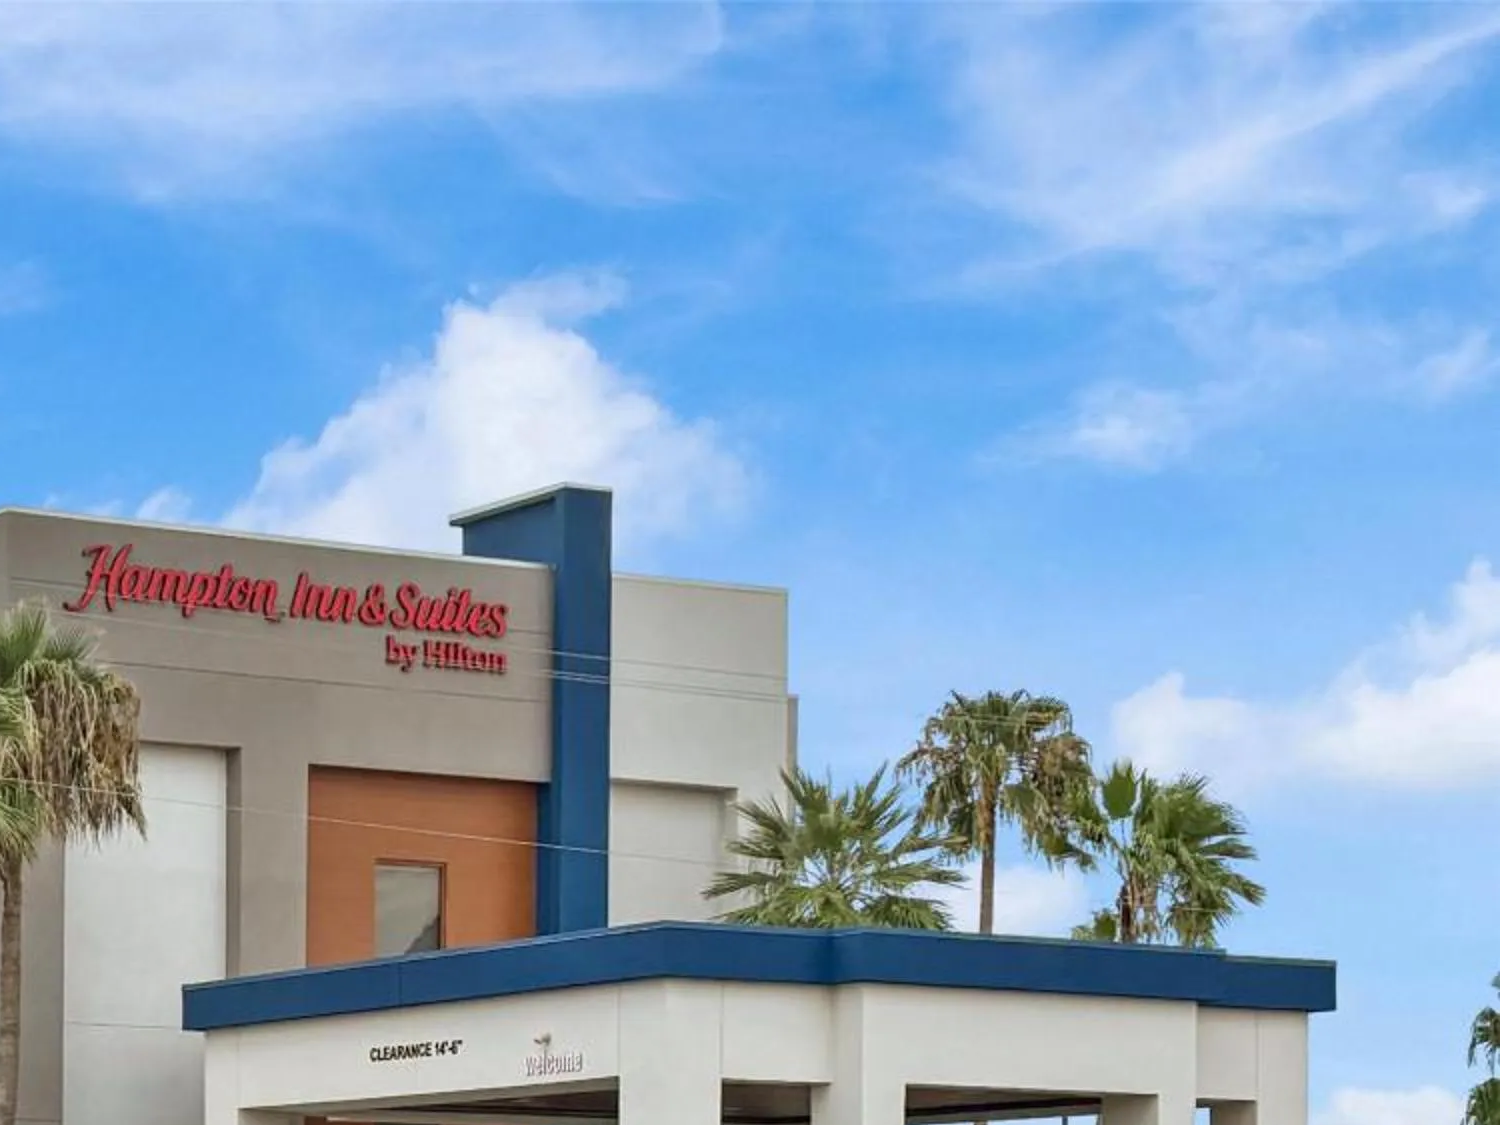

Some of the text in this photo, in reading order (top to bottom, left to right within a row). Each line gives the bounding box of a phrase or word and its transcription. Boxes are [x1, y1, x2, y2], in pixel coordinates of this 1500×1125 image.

[62, 543, 286, 624] Hampton
[290, 570, 357, 624] Inn
[389, 580, 508, 637] Suites
[385, 634, 507, 675] by Hilton
[369, 1041, 433, 1062] CLEARANCE
